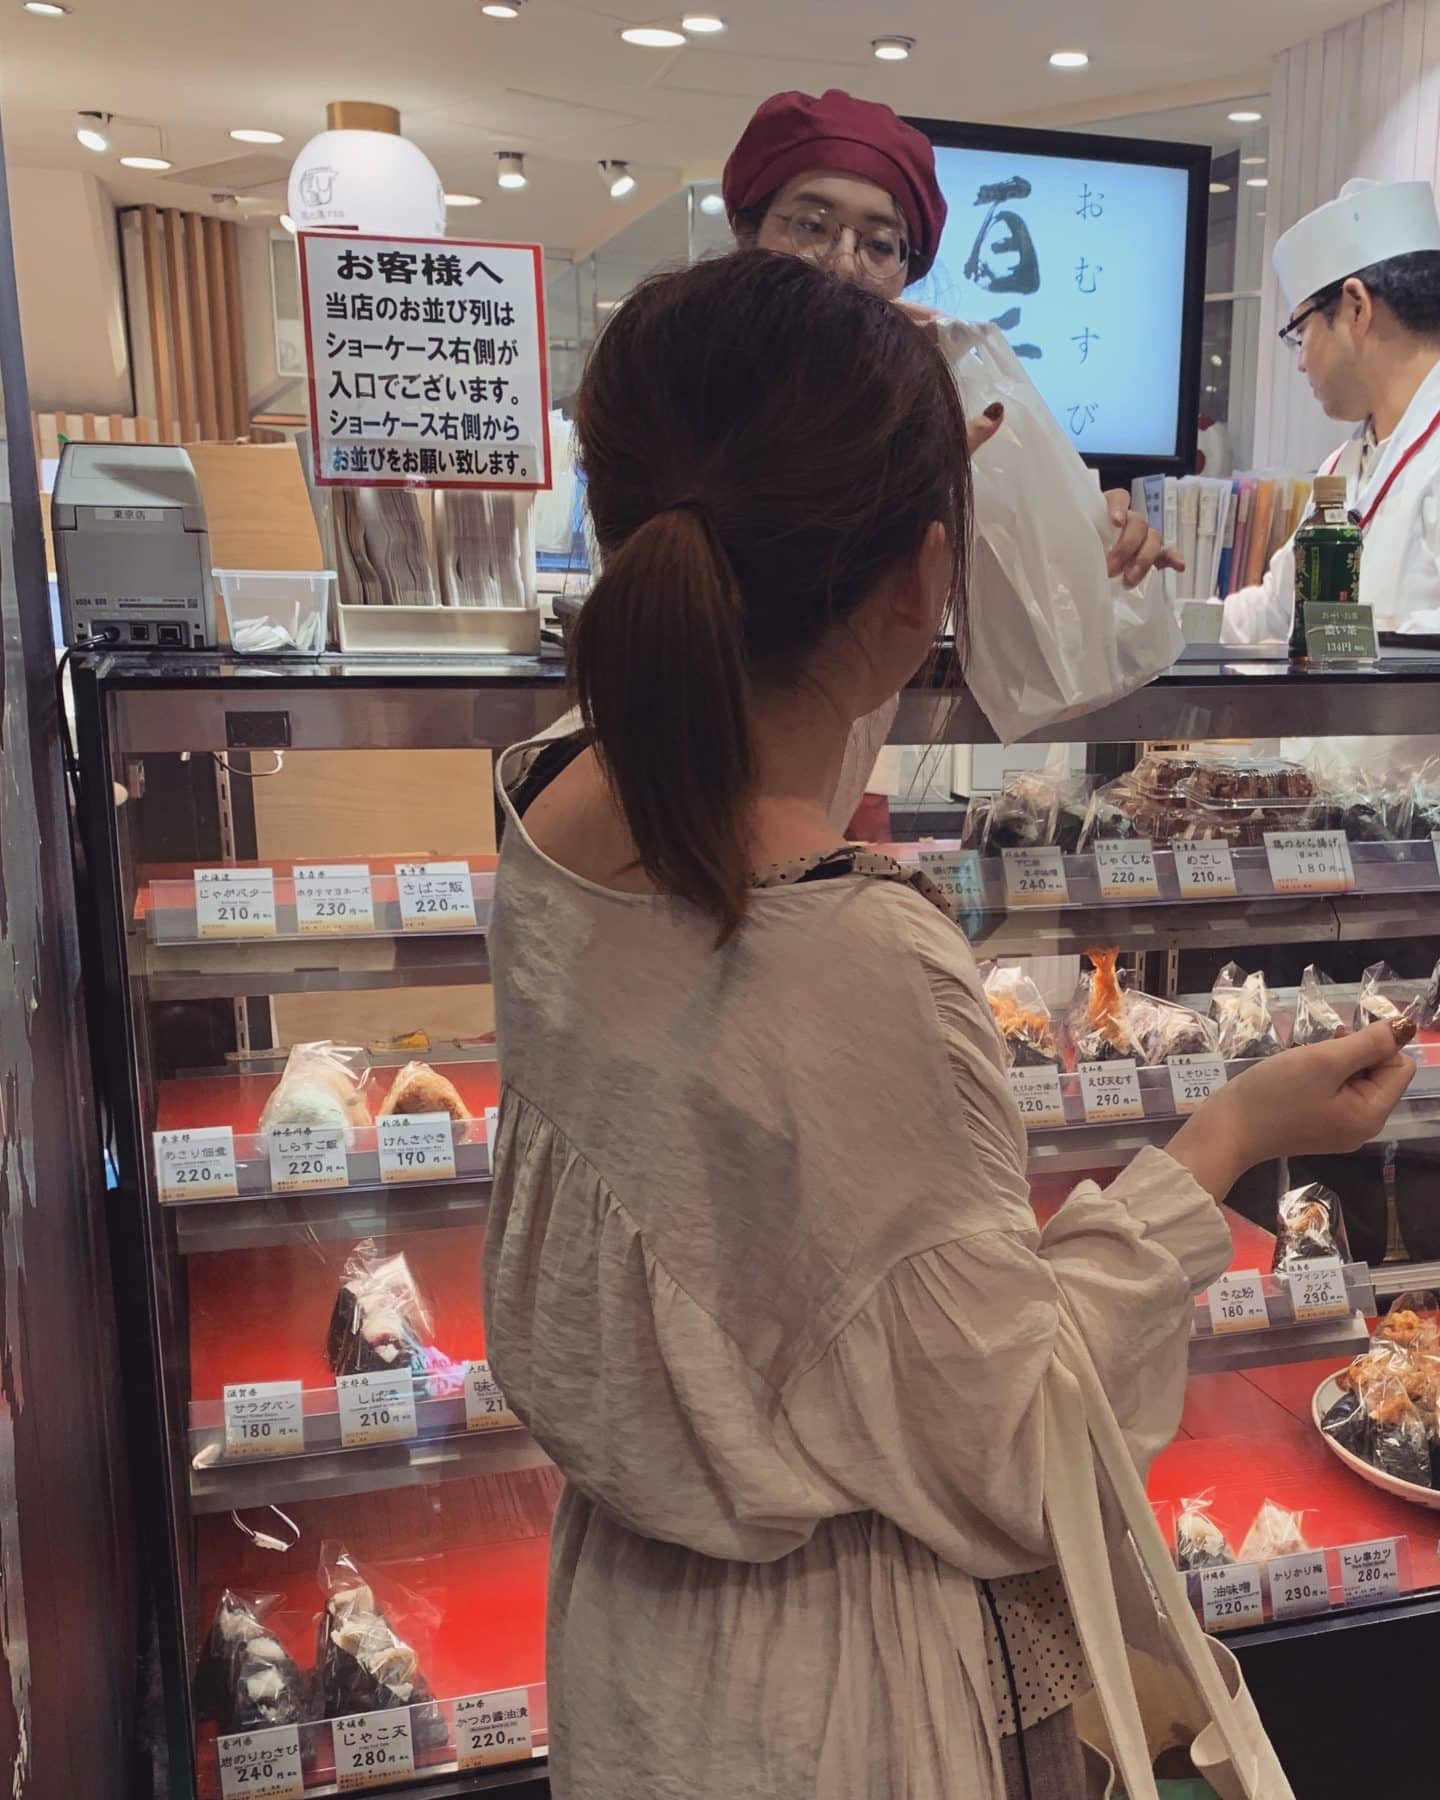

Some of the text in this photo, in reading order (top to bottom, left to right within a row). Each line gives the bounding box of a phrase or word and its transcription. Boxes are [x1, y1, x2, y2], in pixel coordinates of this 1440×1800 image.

[336, 249, 504, 287] お客様へ
[325, 291, 515, 326] 当店のお並び列は
[1066, 183, 1105, 436] おむすび
[325, 332, 519, 366] ショーケース右側が
[328, 370, 519, 405] 入口でございます。
[328, 409, 520, 441] ショーケース右側から
[332, 445, 528, 477] お並びをお願い致します。
[199, 888, 273, 899] じゃがバター
[402, 881, 465, 896] さばご飯
[278, 1139, 337, 1152] しらすご飯
[234, 1400, 296, 1413] サラダパン
[343, 1724, 409, 1746] じゃこ天
